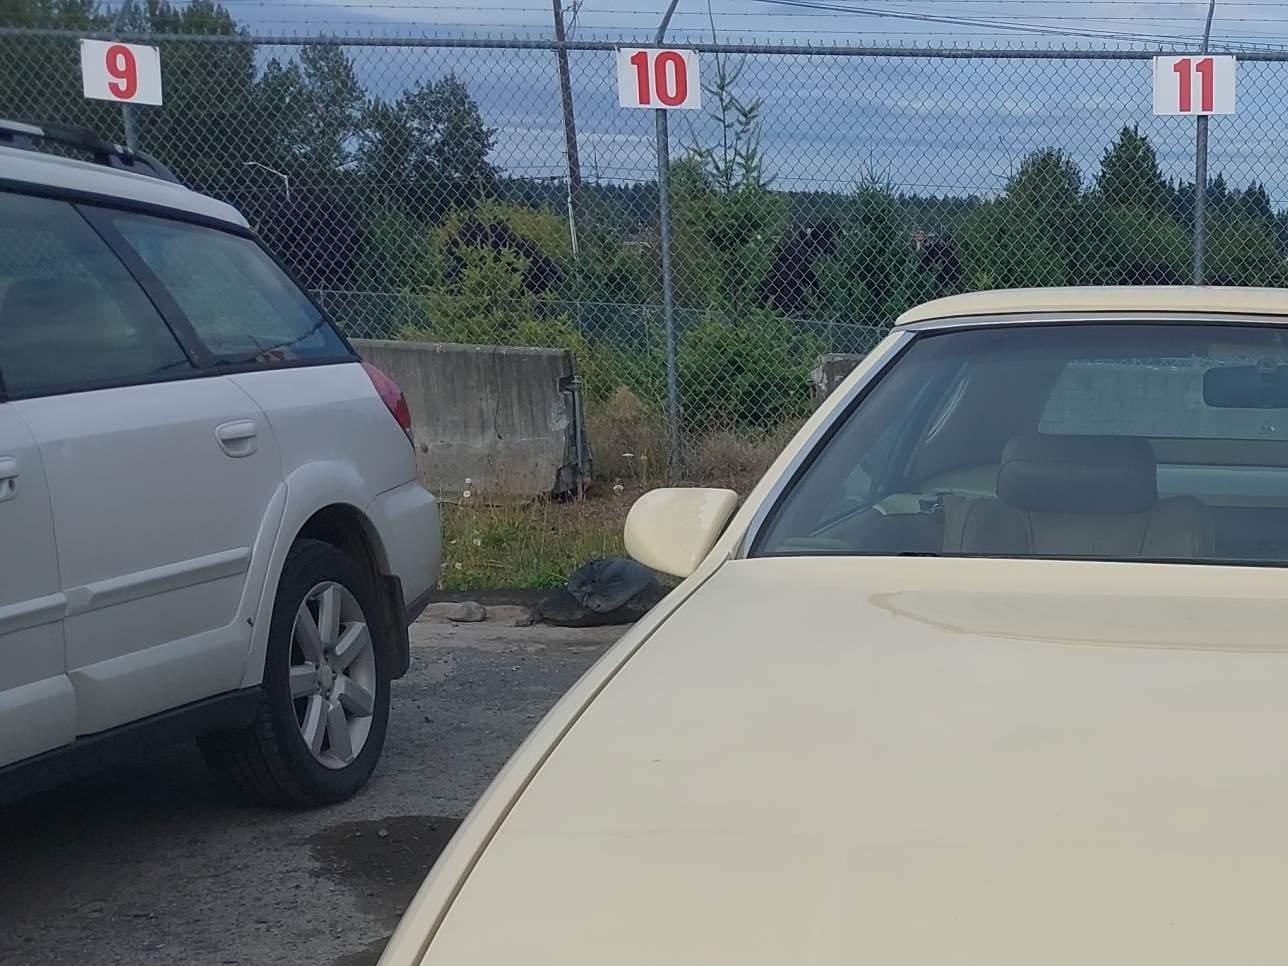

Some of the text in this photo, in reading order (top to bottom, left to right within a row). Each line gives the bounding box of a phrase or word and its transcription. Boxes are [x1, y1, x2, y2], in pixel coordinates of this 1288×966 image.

[106, 45, 137, 99] 9
[631, 51, 687, 106] 10
[1174, 58, 1213, 112] 11
